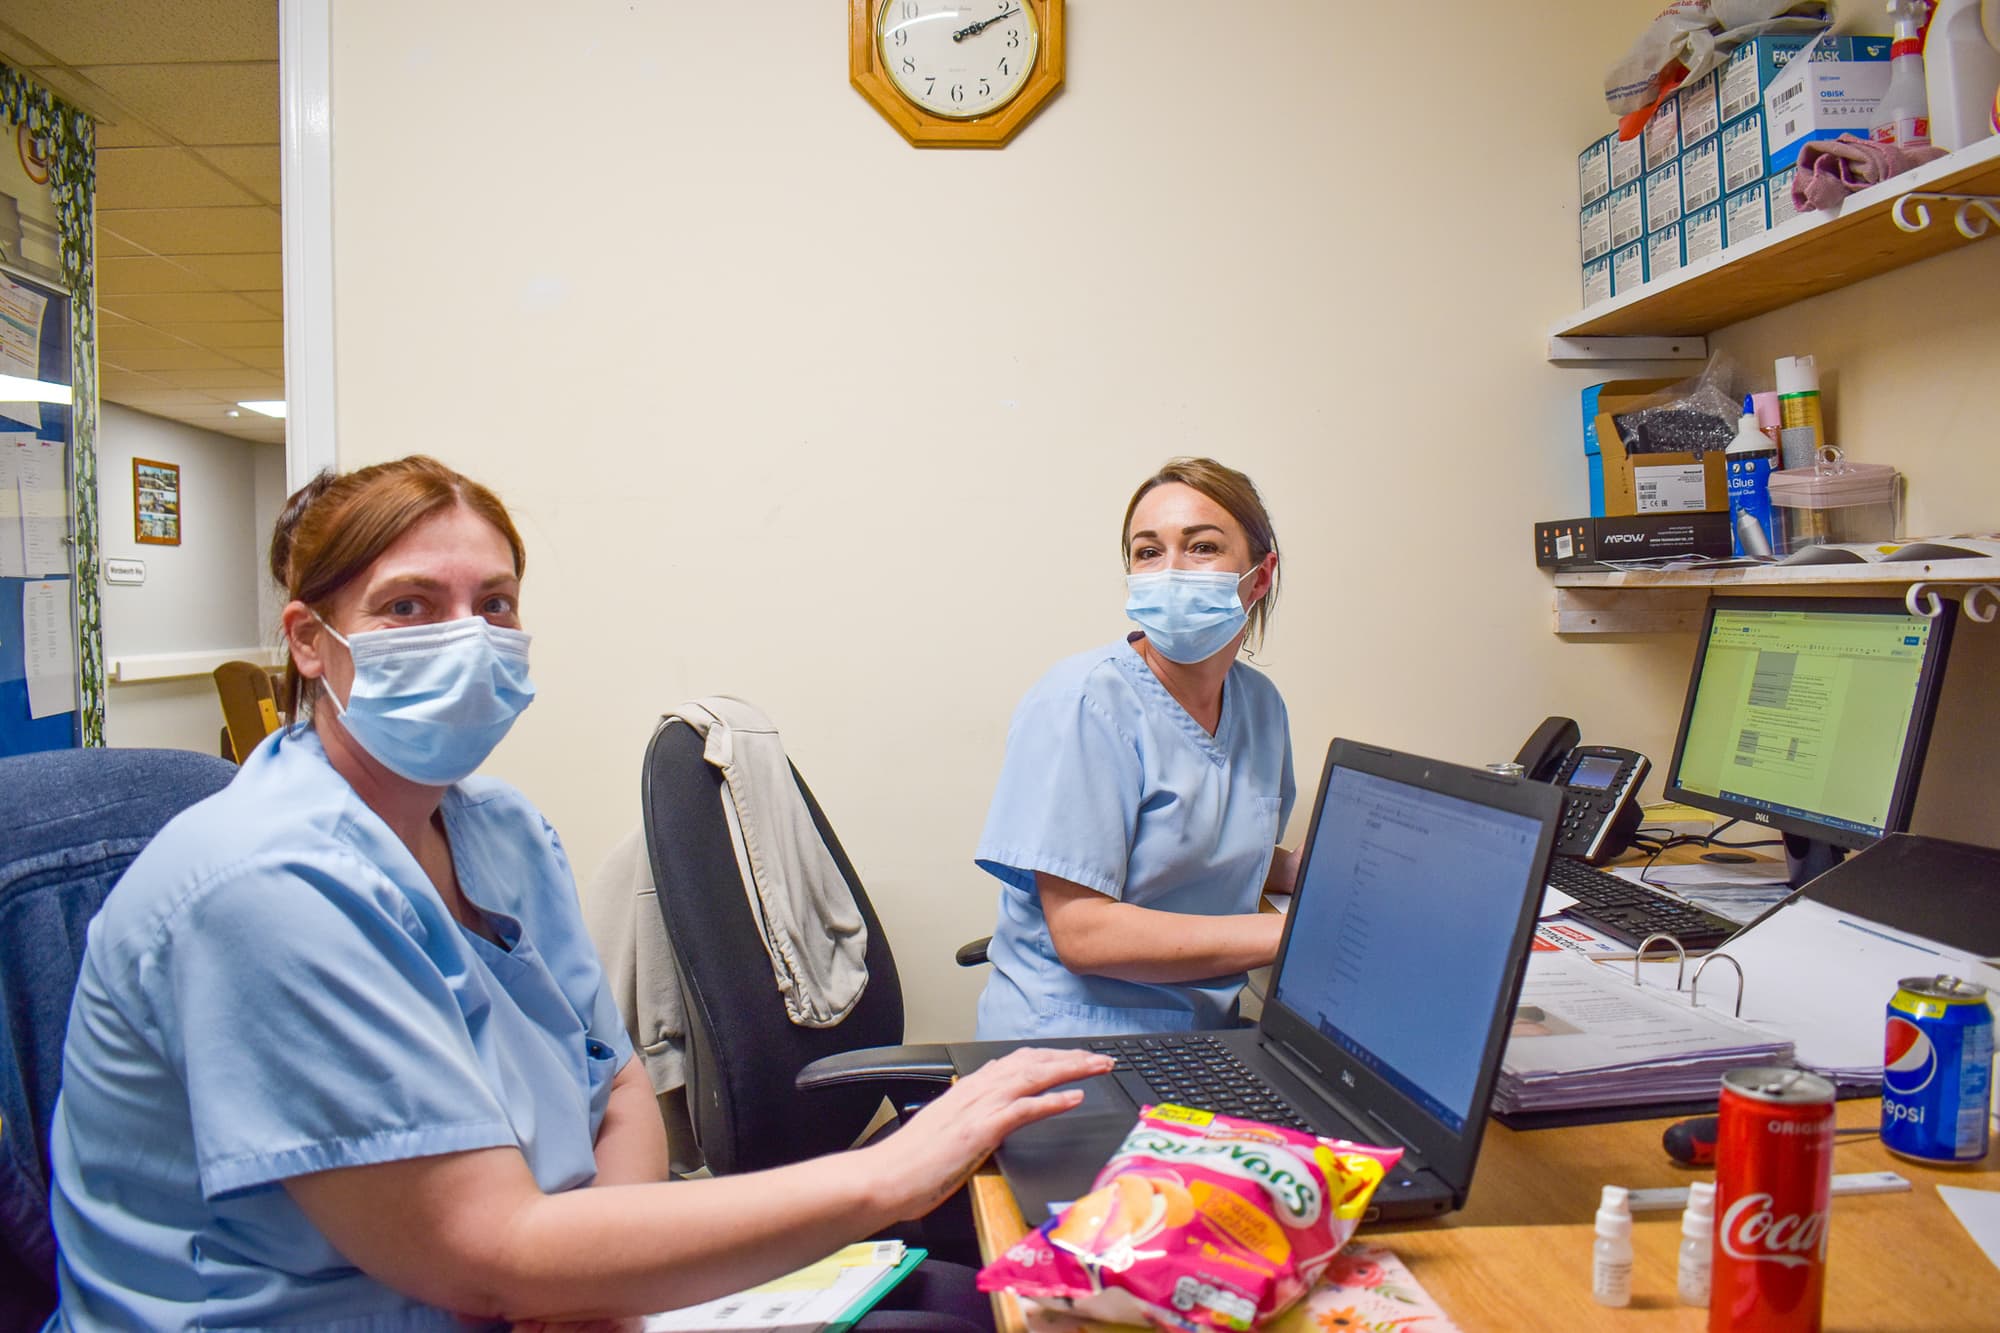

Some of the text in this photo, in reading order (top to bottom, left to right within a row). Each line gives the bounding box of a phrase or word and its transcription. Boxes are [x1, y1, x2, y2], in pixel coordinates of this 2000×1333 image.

[901, 4, 919, 20] 10
[895, 30, 908, 46] 9
[1007, 30, 1019, 48] 3
[902, 56, 916, 73] 8
[1772, 50, 1797, 62] FAC
[997, 57, 1009, 75] 4
[925, 77, 936, 96] 7
[951, 84, 964, 102] 6
[978, 78, 991, 96] 5
[1733, 478, 1754, 488] Glue
[1604, 533, 1645, 544] MPOW
